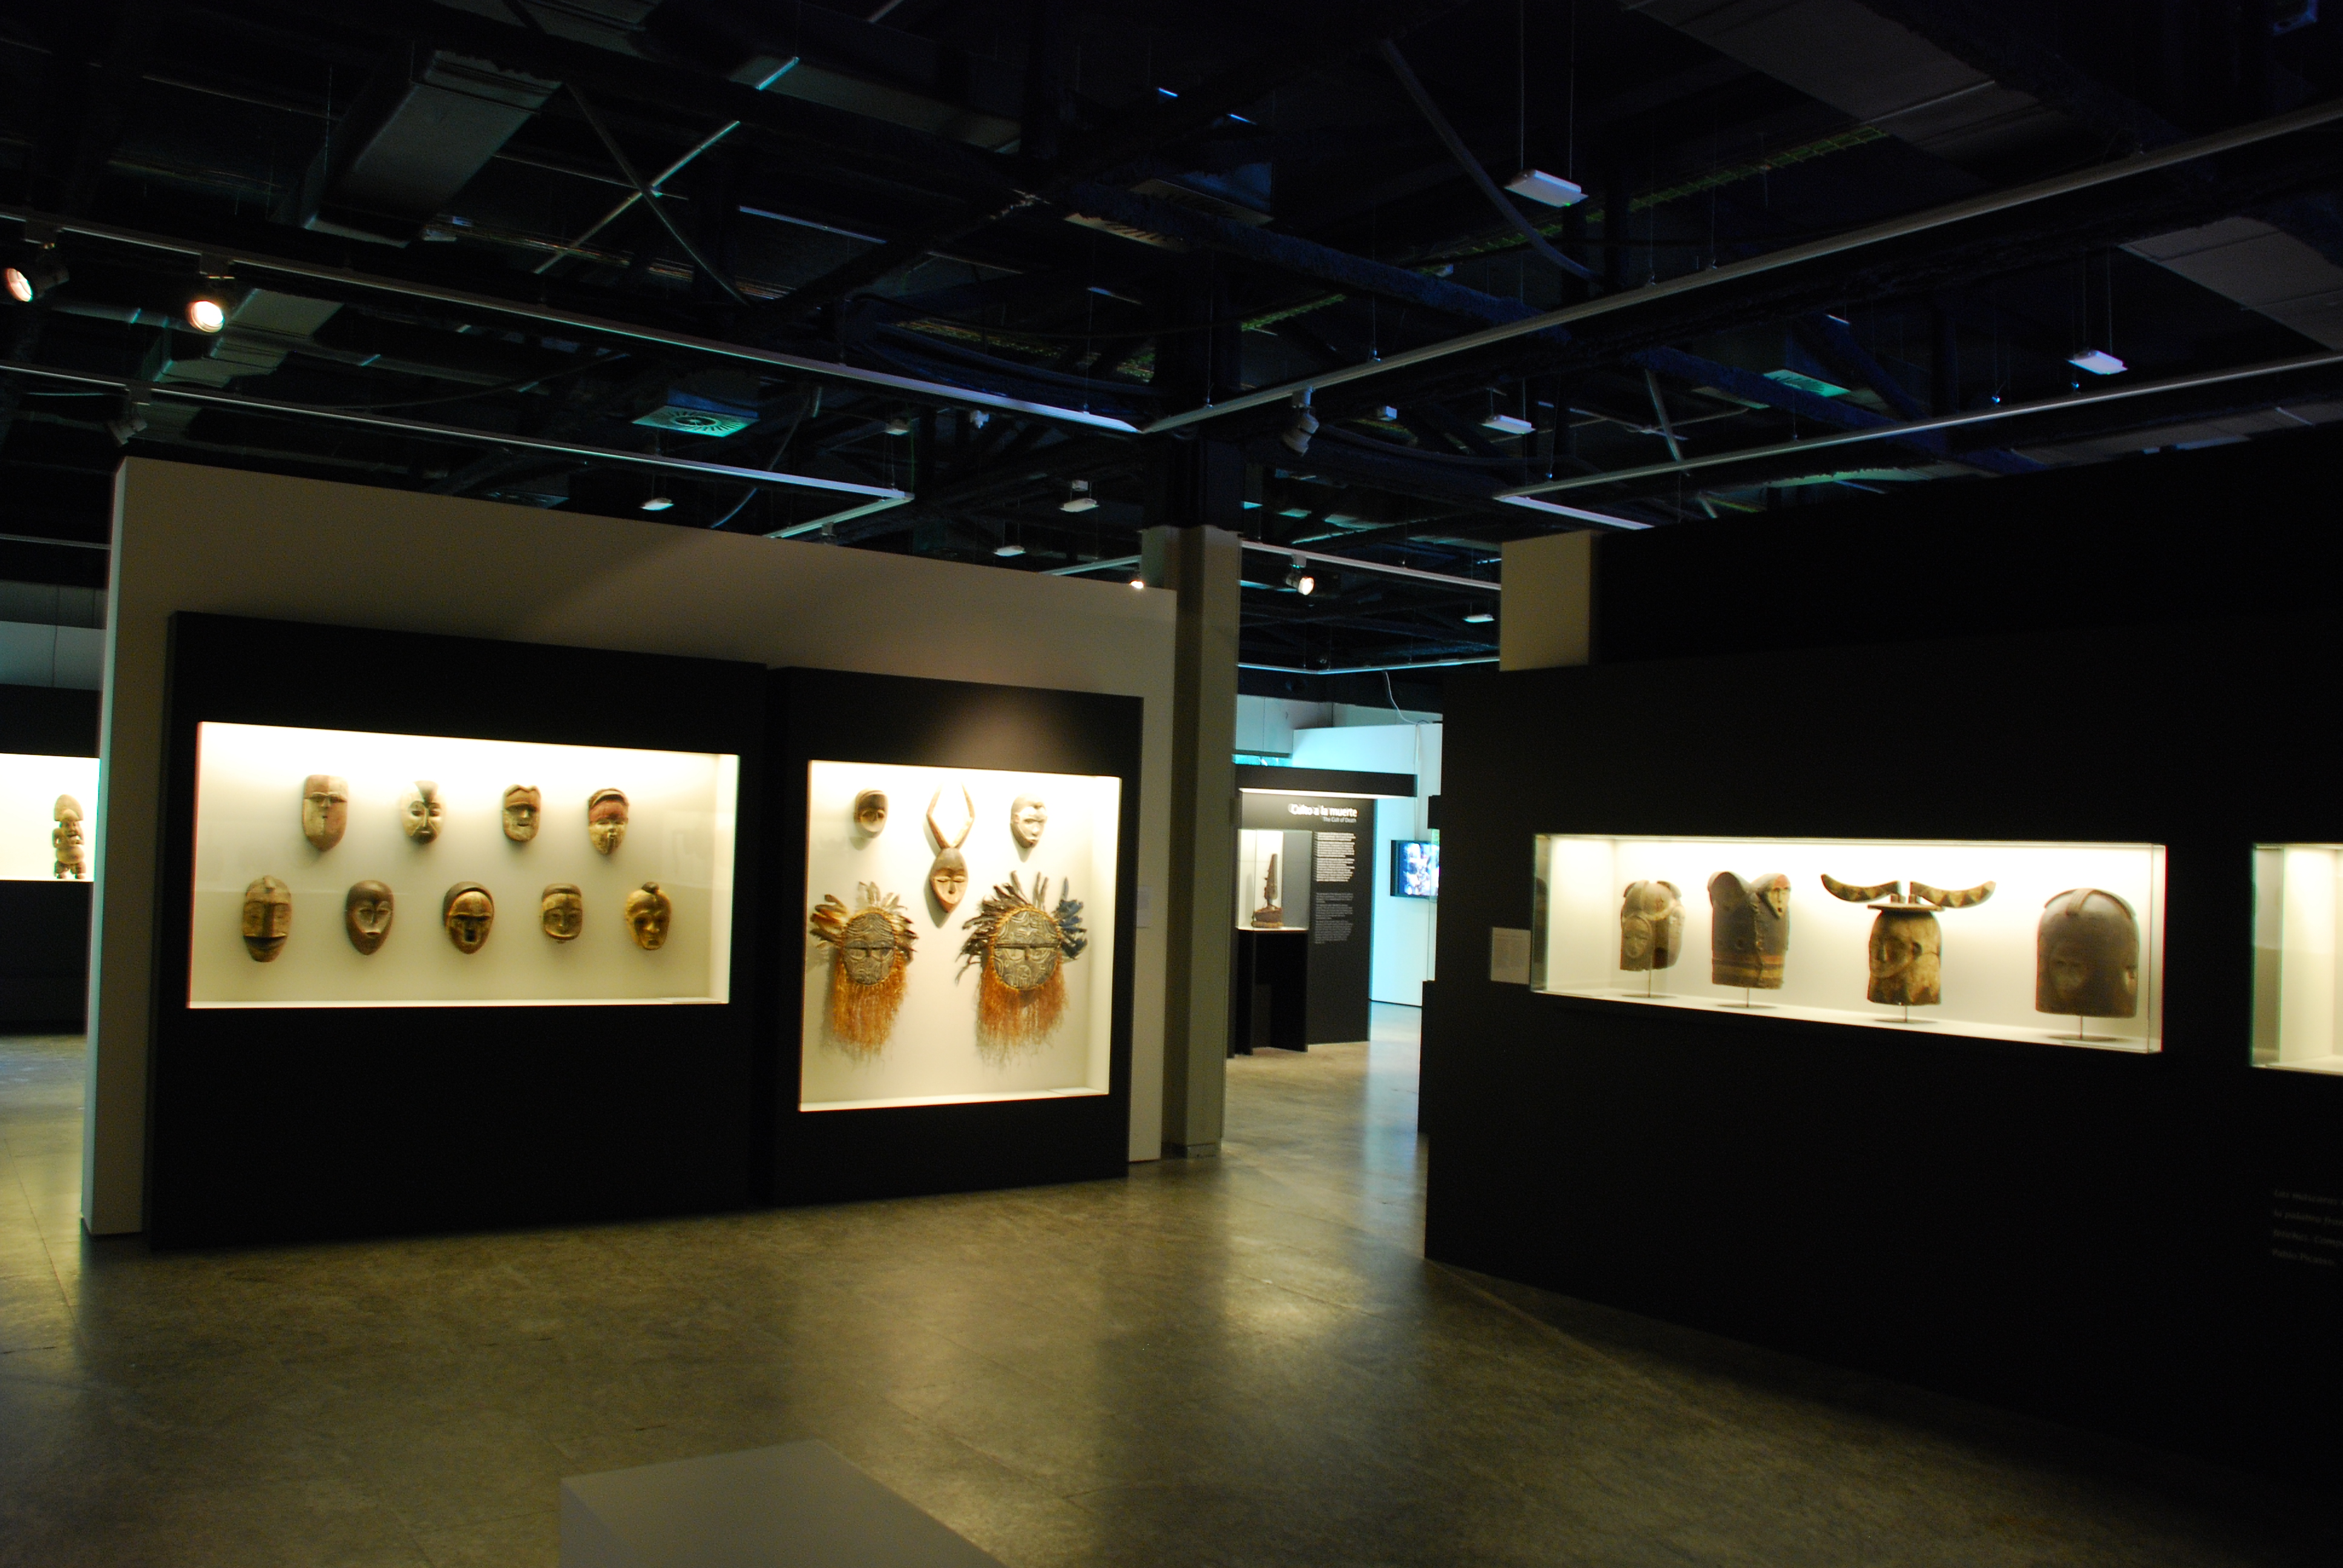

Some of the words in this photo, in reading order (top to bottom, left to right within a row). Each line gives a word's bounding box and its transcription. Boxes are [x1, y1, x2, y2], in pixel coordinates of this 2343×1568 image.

[1313, 807, 1320, 816] a
[1320, 805, 1328, 816] la
[1329, 808, 1357, 817] muerte
